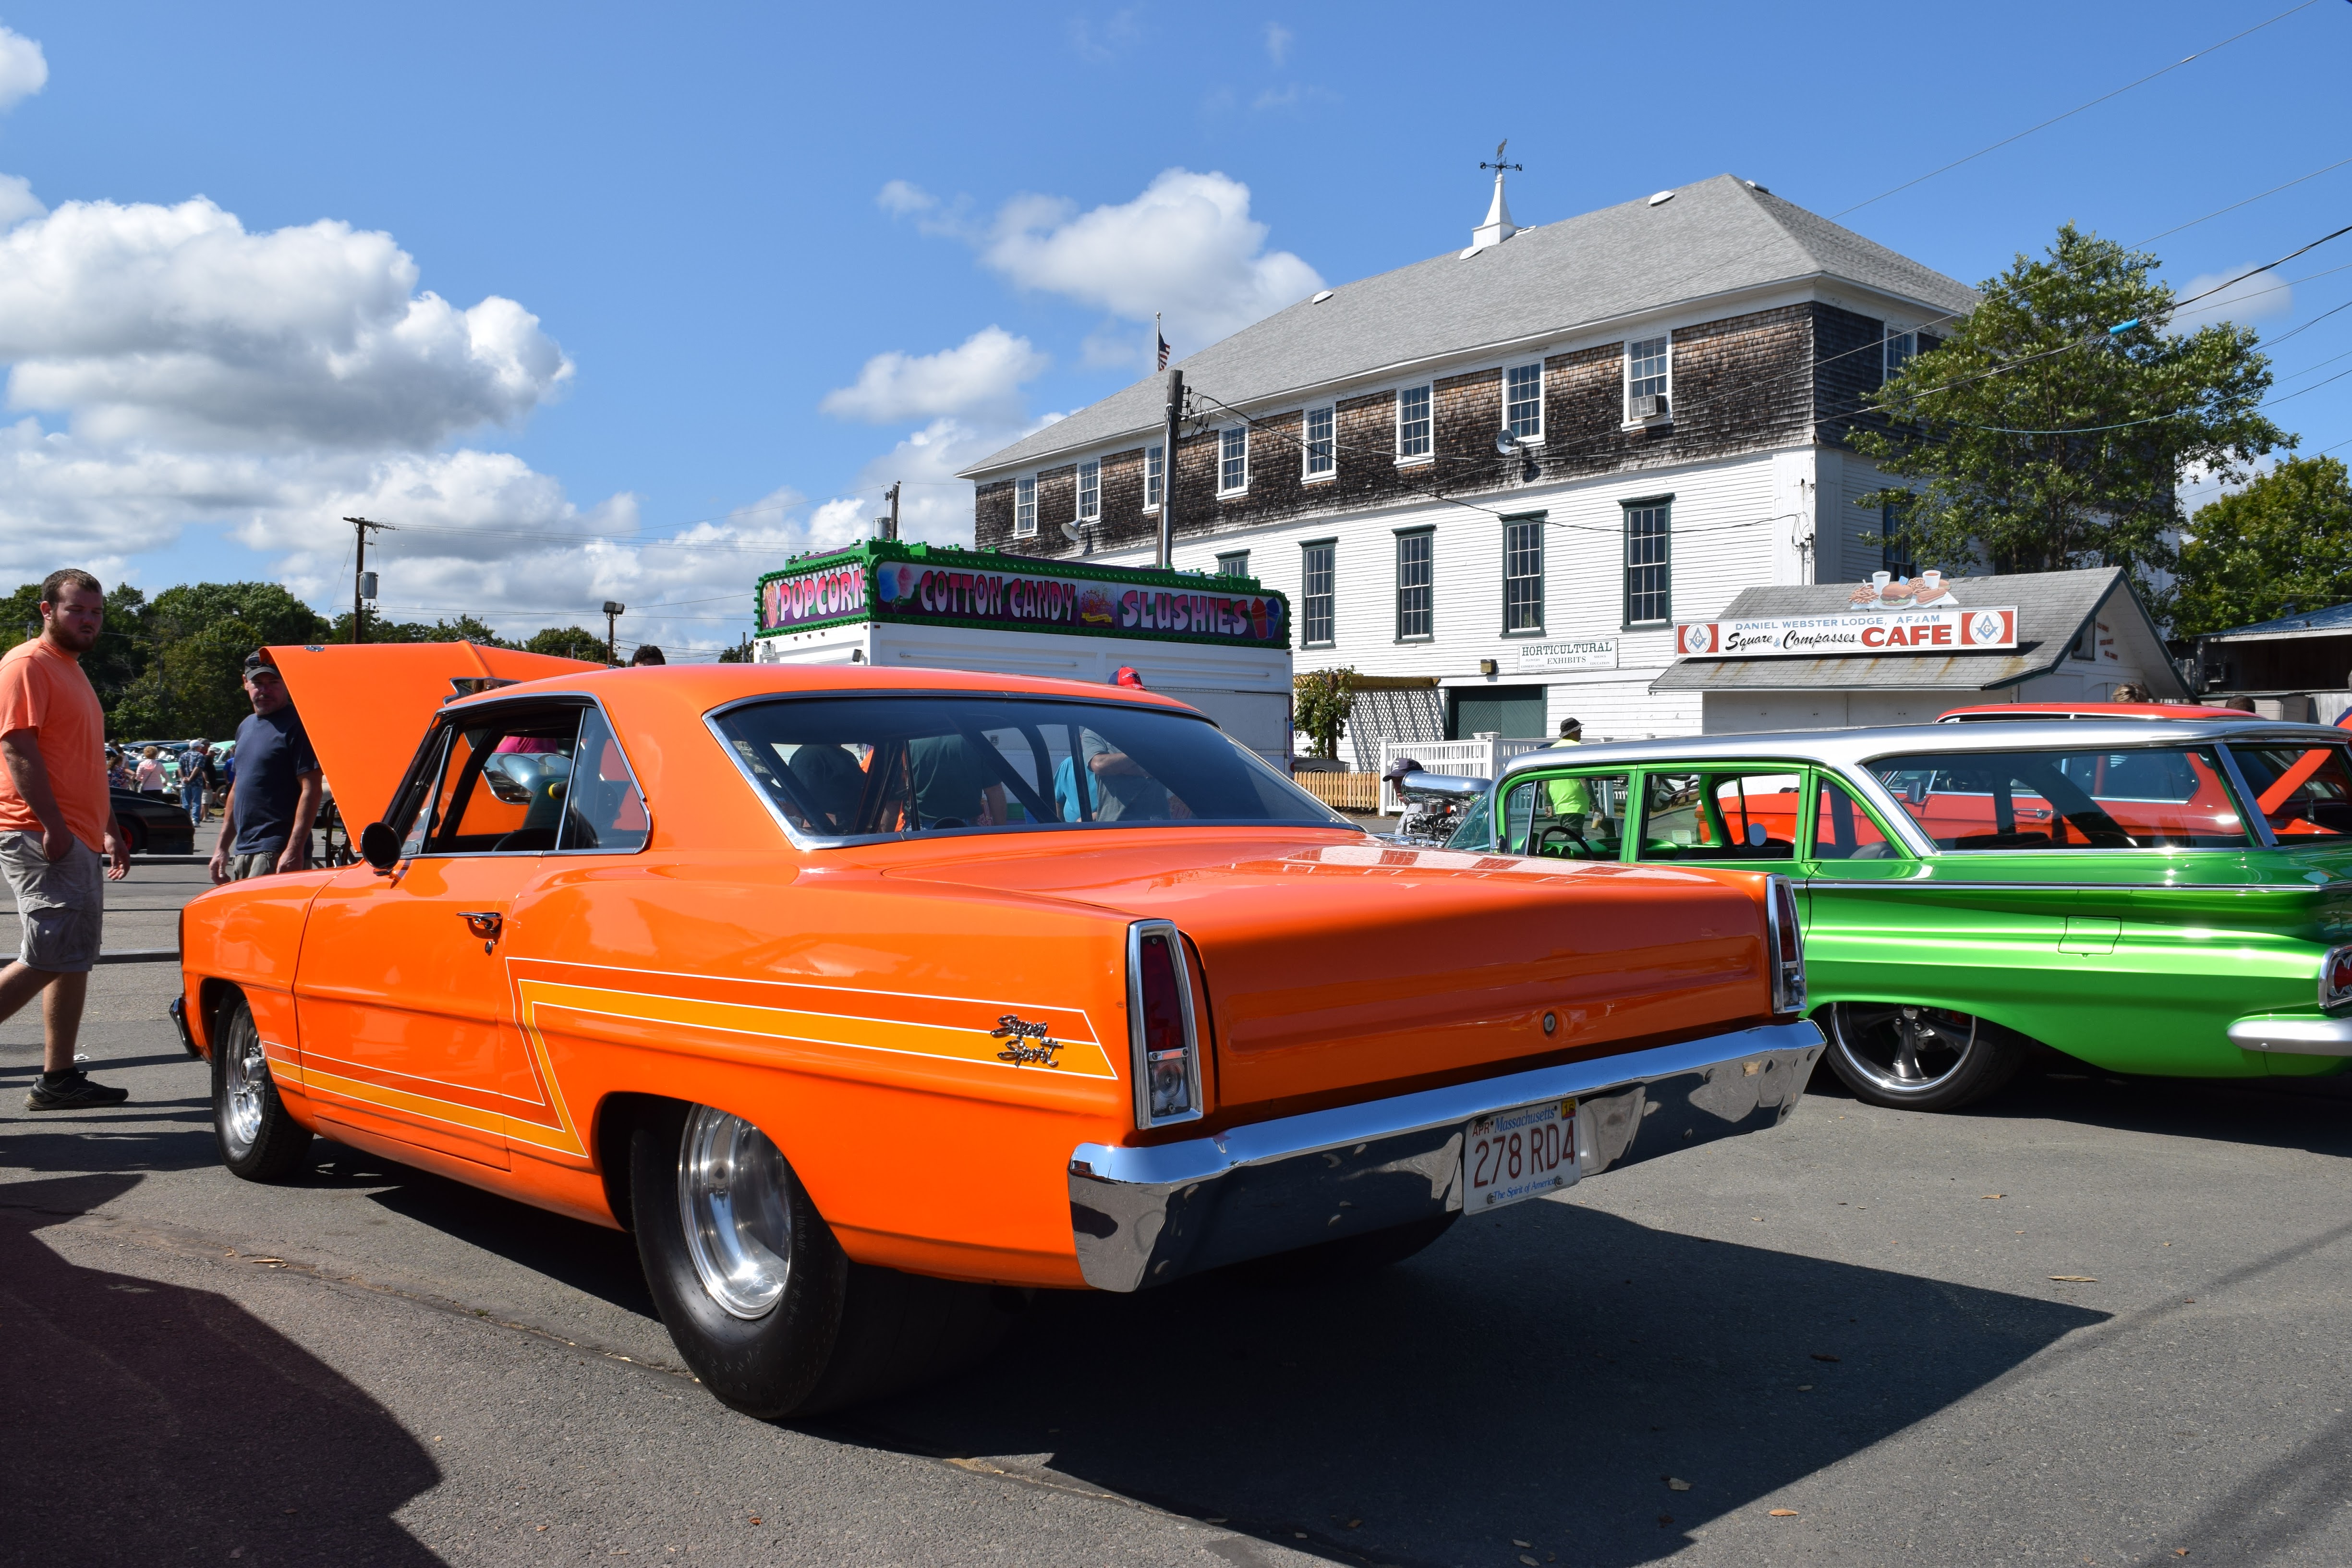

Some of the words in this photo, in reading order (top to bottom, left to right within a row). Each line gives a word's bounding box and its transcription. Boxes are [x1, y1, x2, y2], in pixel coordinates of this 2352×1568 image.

[780, 568, 866, 621] POPCORN
[920, 570, 1002, 615] COTTON
[1009, 578, 1076, 621] CANDY
[1122, 590, 1247, 635] SLUSHIES
[1735, 622, 1778, 630] DANIEL
[1782, 619, 1838, 628] WEBSTER
[1842, 617, 1887, 626] LODGE,
[1725, 632, 1772, 651] Square
[1773, 637, 1781, 647] &
[1783, 630, 1858, 649] Compasses
[1861, 624, 1952, 647] CAFE
[1522, 642, 1612, 656] HORTICULTURAL
[1547, 656, 1586, 664] EXHIBITS
[997, 1039, 1064, 1069] Sport
[1472, 1122, 1490, 1137] APR
[1494, 1107, 1555, 1133] Massachusetts
[1474, 1133, 1522, 1188] 278
[1531, 1120, 1576, 1175] RD4
[1507, 1185, 1523, 1198] Spirit
[1524, 1182, 1531, 1191] of
[1531, 1178, 1556, 1190] America
